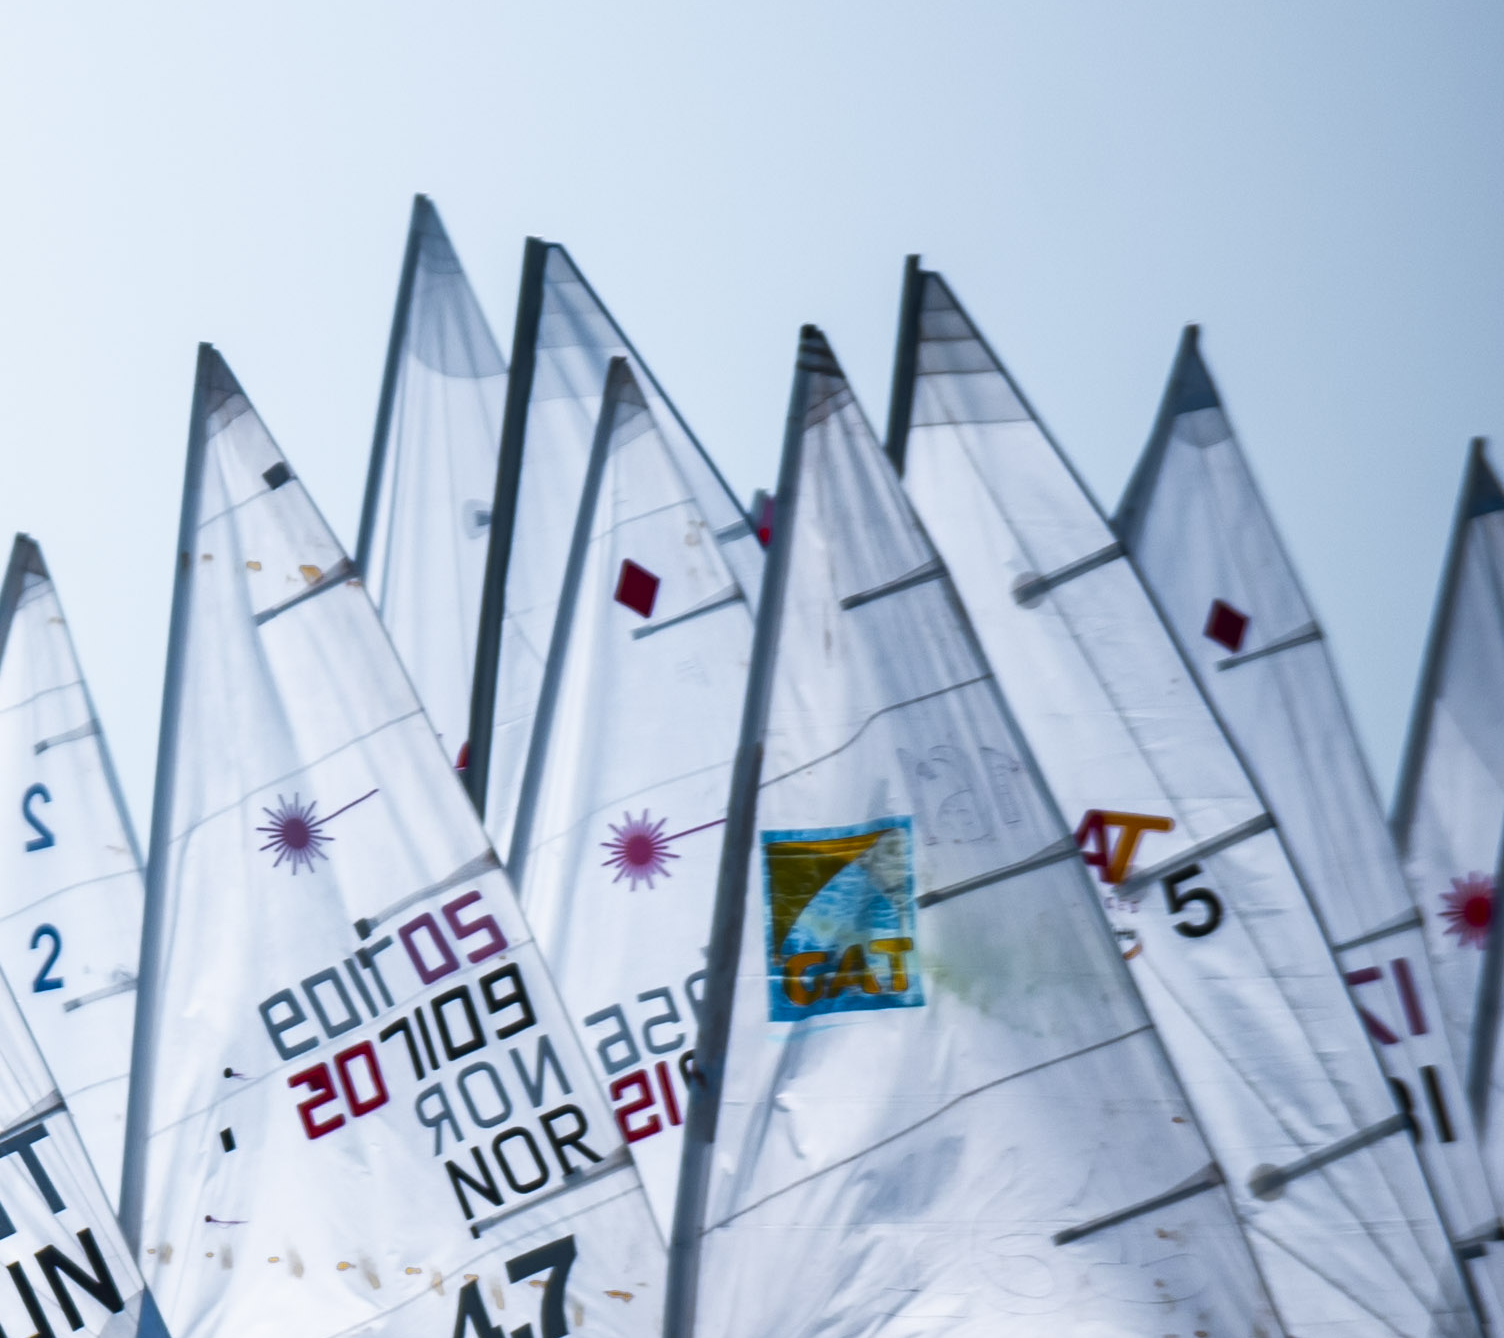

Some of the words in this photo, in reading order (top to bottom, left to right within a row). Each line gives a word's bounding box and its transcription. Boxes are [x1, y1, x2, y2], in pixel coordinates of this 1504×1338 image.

[1073, 809, 1176, 886] AT
[1159, 862, 1224, 939] 5
[29, 922, 65, 993] 2
[783, 937, 914, 1007] GAT
[287, 962, 537, 1141] 207109
[444, 1103, 605, 1221] NOR
